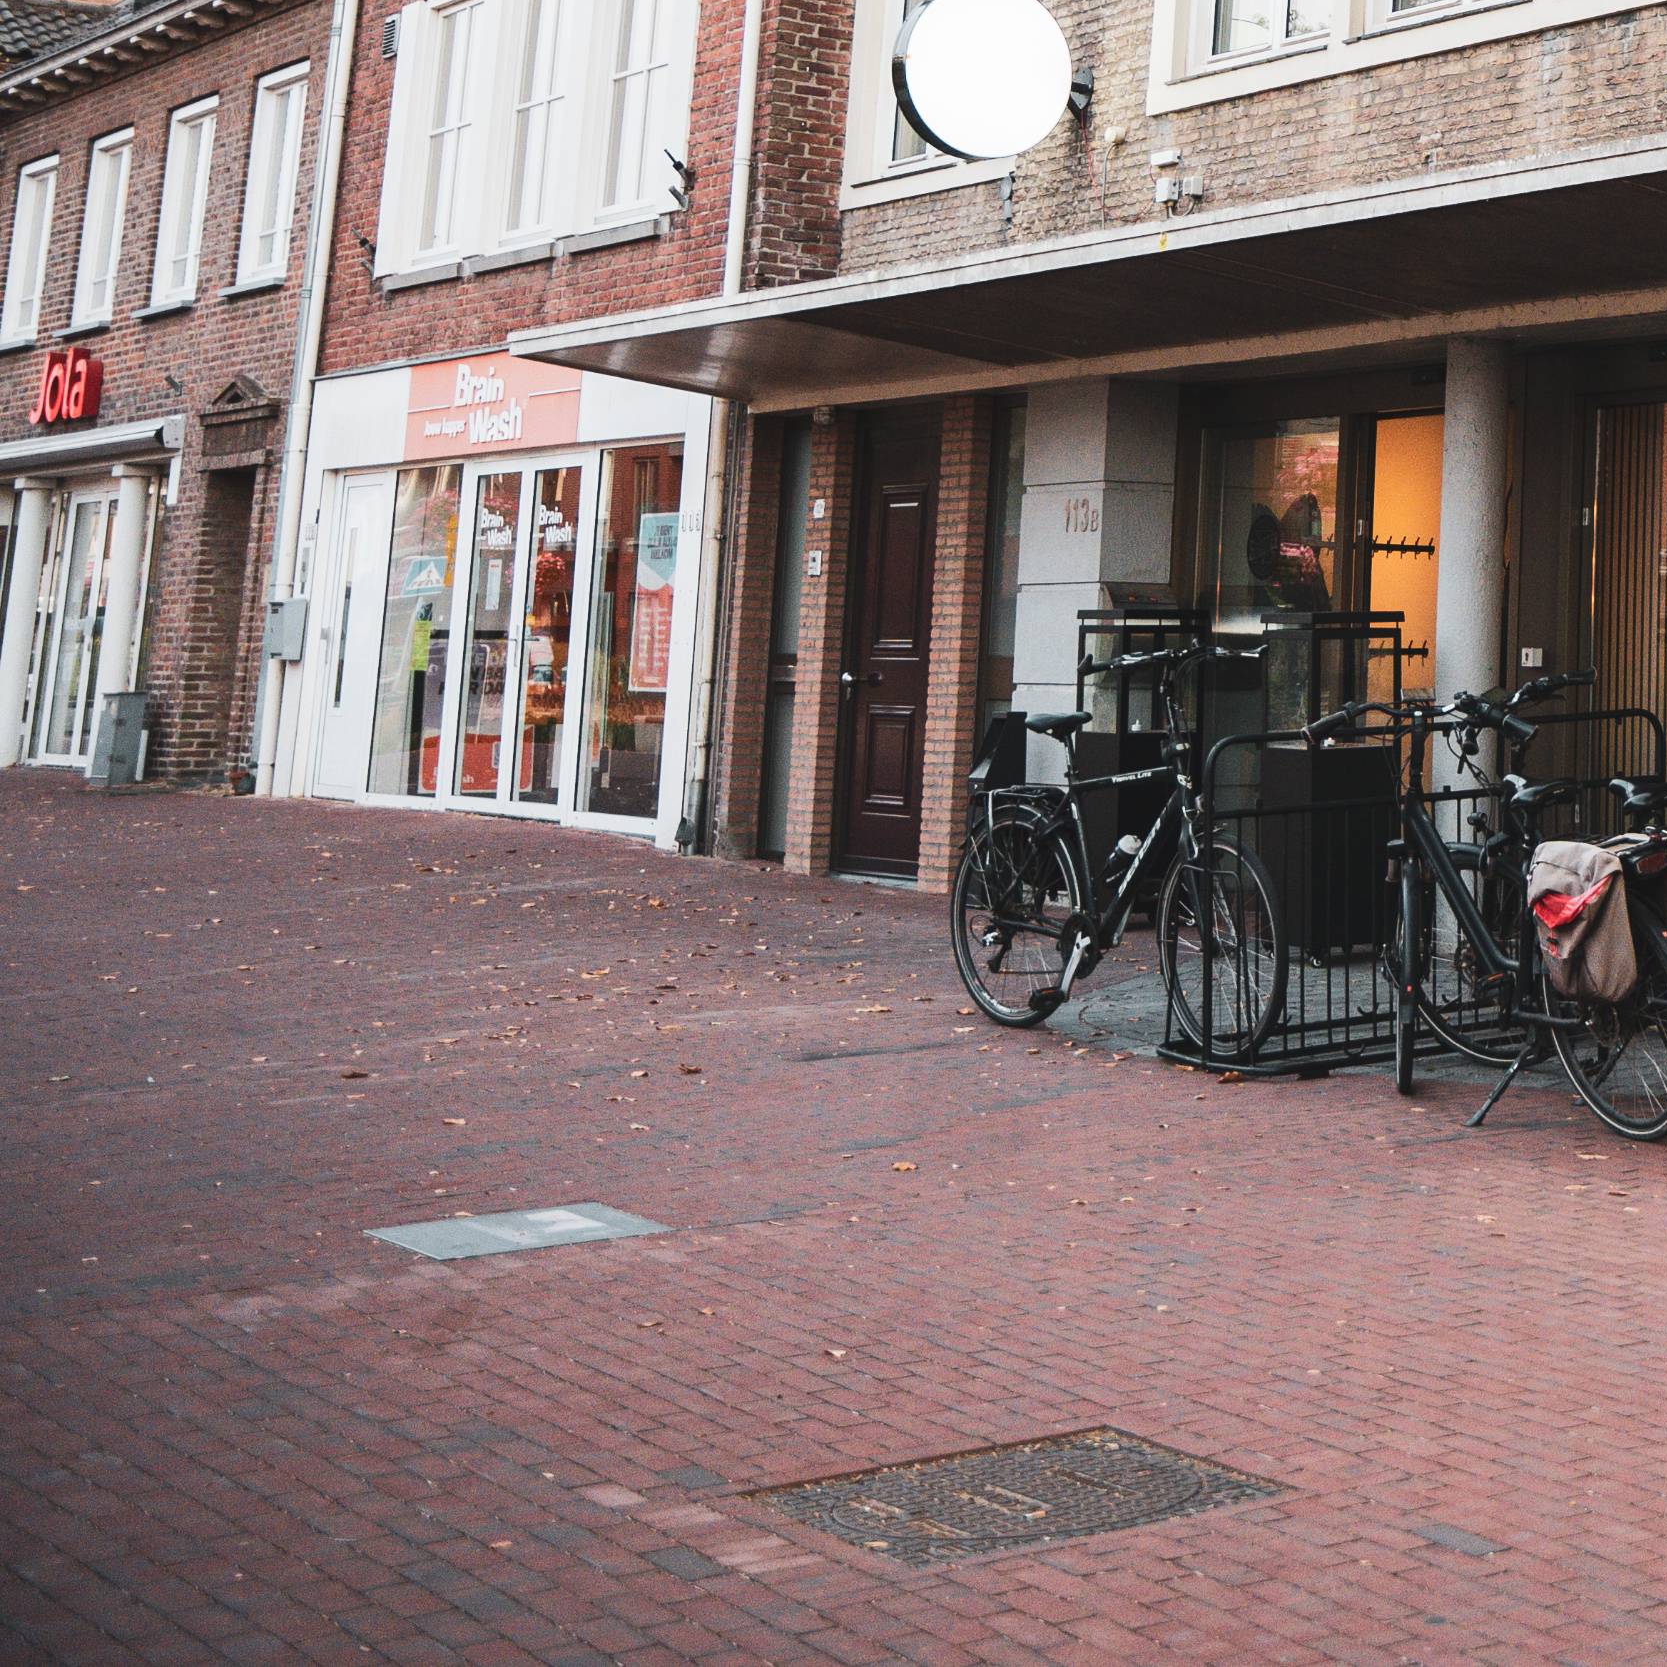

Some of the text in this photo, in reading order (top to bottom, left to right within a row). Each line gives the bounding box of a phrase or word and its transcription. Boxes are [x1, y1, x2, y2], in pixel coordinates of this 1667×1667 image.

[29, 346, 89, 425] Jola
[454, 363, 505, 407] Brain
[468, 397, 523, 444] Wash
[480, 507, 504, 528] Brain
[538, 504, 564, 526] Brain
[486, 525, 512, 546] Wash
[545, 521, 572, 543] Wash
